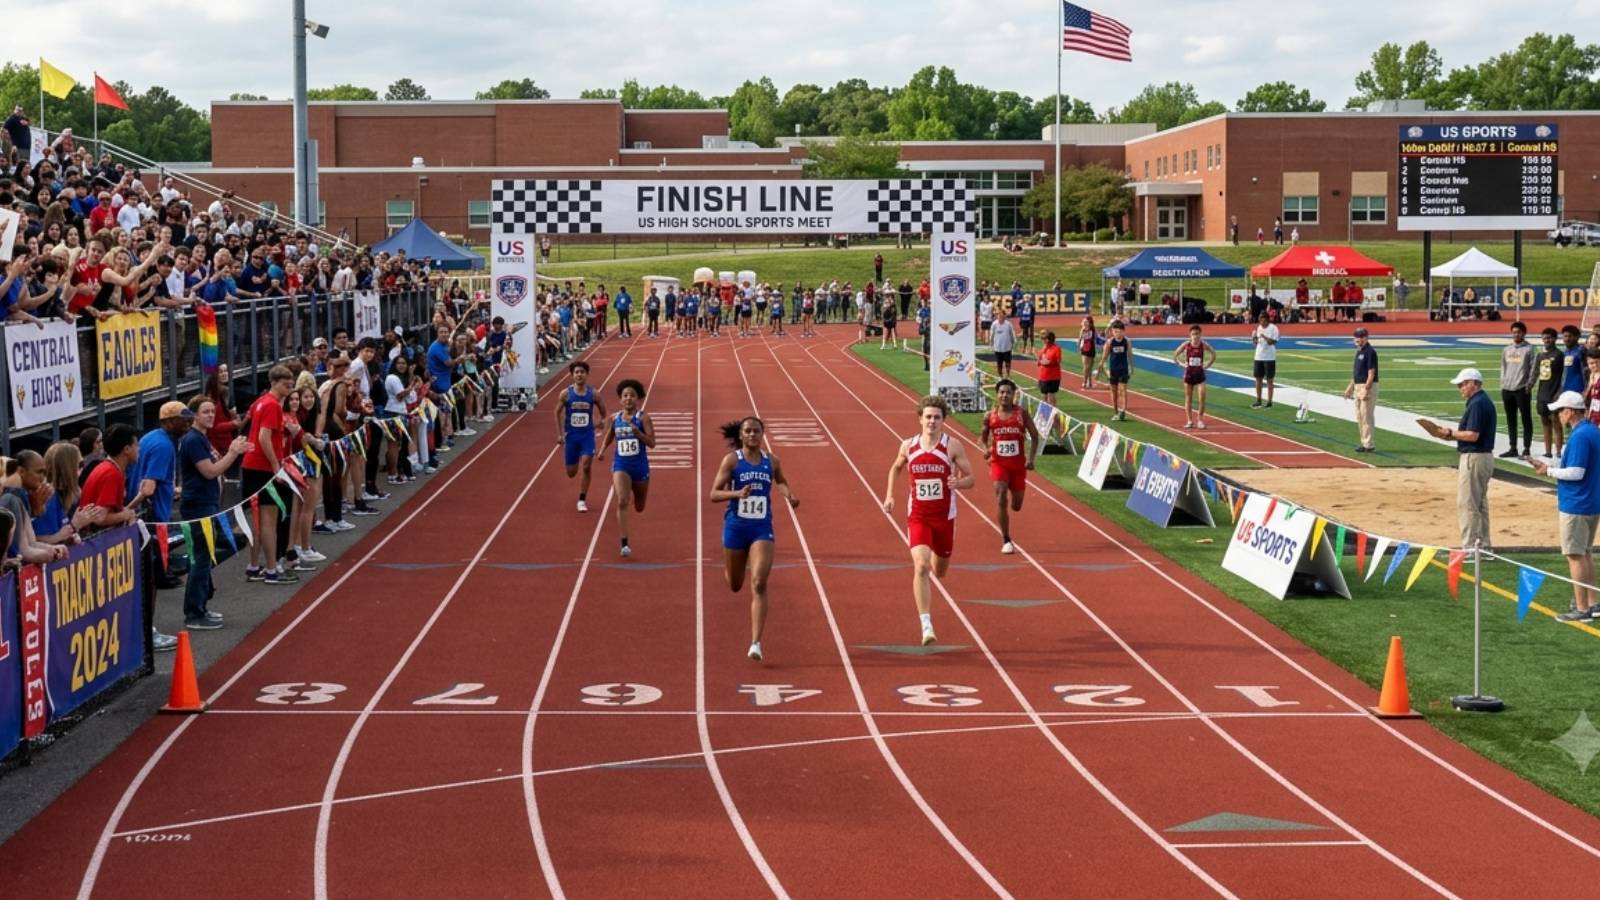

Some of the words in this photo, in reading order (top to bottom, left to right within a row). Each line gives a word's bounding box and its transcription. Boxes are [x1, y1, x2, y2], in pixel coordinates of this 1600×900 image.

[1440, 126, 1458, 138] US
[637, 186, 747, 212] FINISH
[760, 186, 834, 212] LINE
[638, 217, 655, 228] US
[658, 217, 688, 228] HIGH
[692, 217, 743, 228] SCHOOL
[745, 217, 794, 228] SPORTS
[798, 217, 832, 228] MEET
[498, 241, 525, 255] US
[941, 240, 967, 255] US
[1502, 288, 1535, 307] GO
[12, 335, 75, 373] CENTRAL
[31, 374, 63, 408] HIGH
[919, 483, 941, 497] 512
[742, 501, 763, 514] 114
[1251, 525, 1297, 565] SPORTS
[52, 555, 95, 629] TRACK
[97, 552, 105, 608] &
[107, 538, 135, 603] FIELD
[70, 611, 120, 693] 2024
[255, 682, 347, 705] 8
[412, 682, 499, 706] 7
[580, 682, 663, 706] 6
[738, 683, 822, 706] 4
[898, 683, 983, 707] 3
[1053, 683, 1146, 707] 2
[1213, 684, 1300, 707] 1
